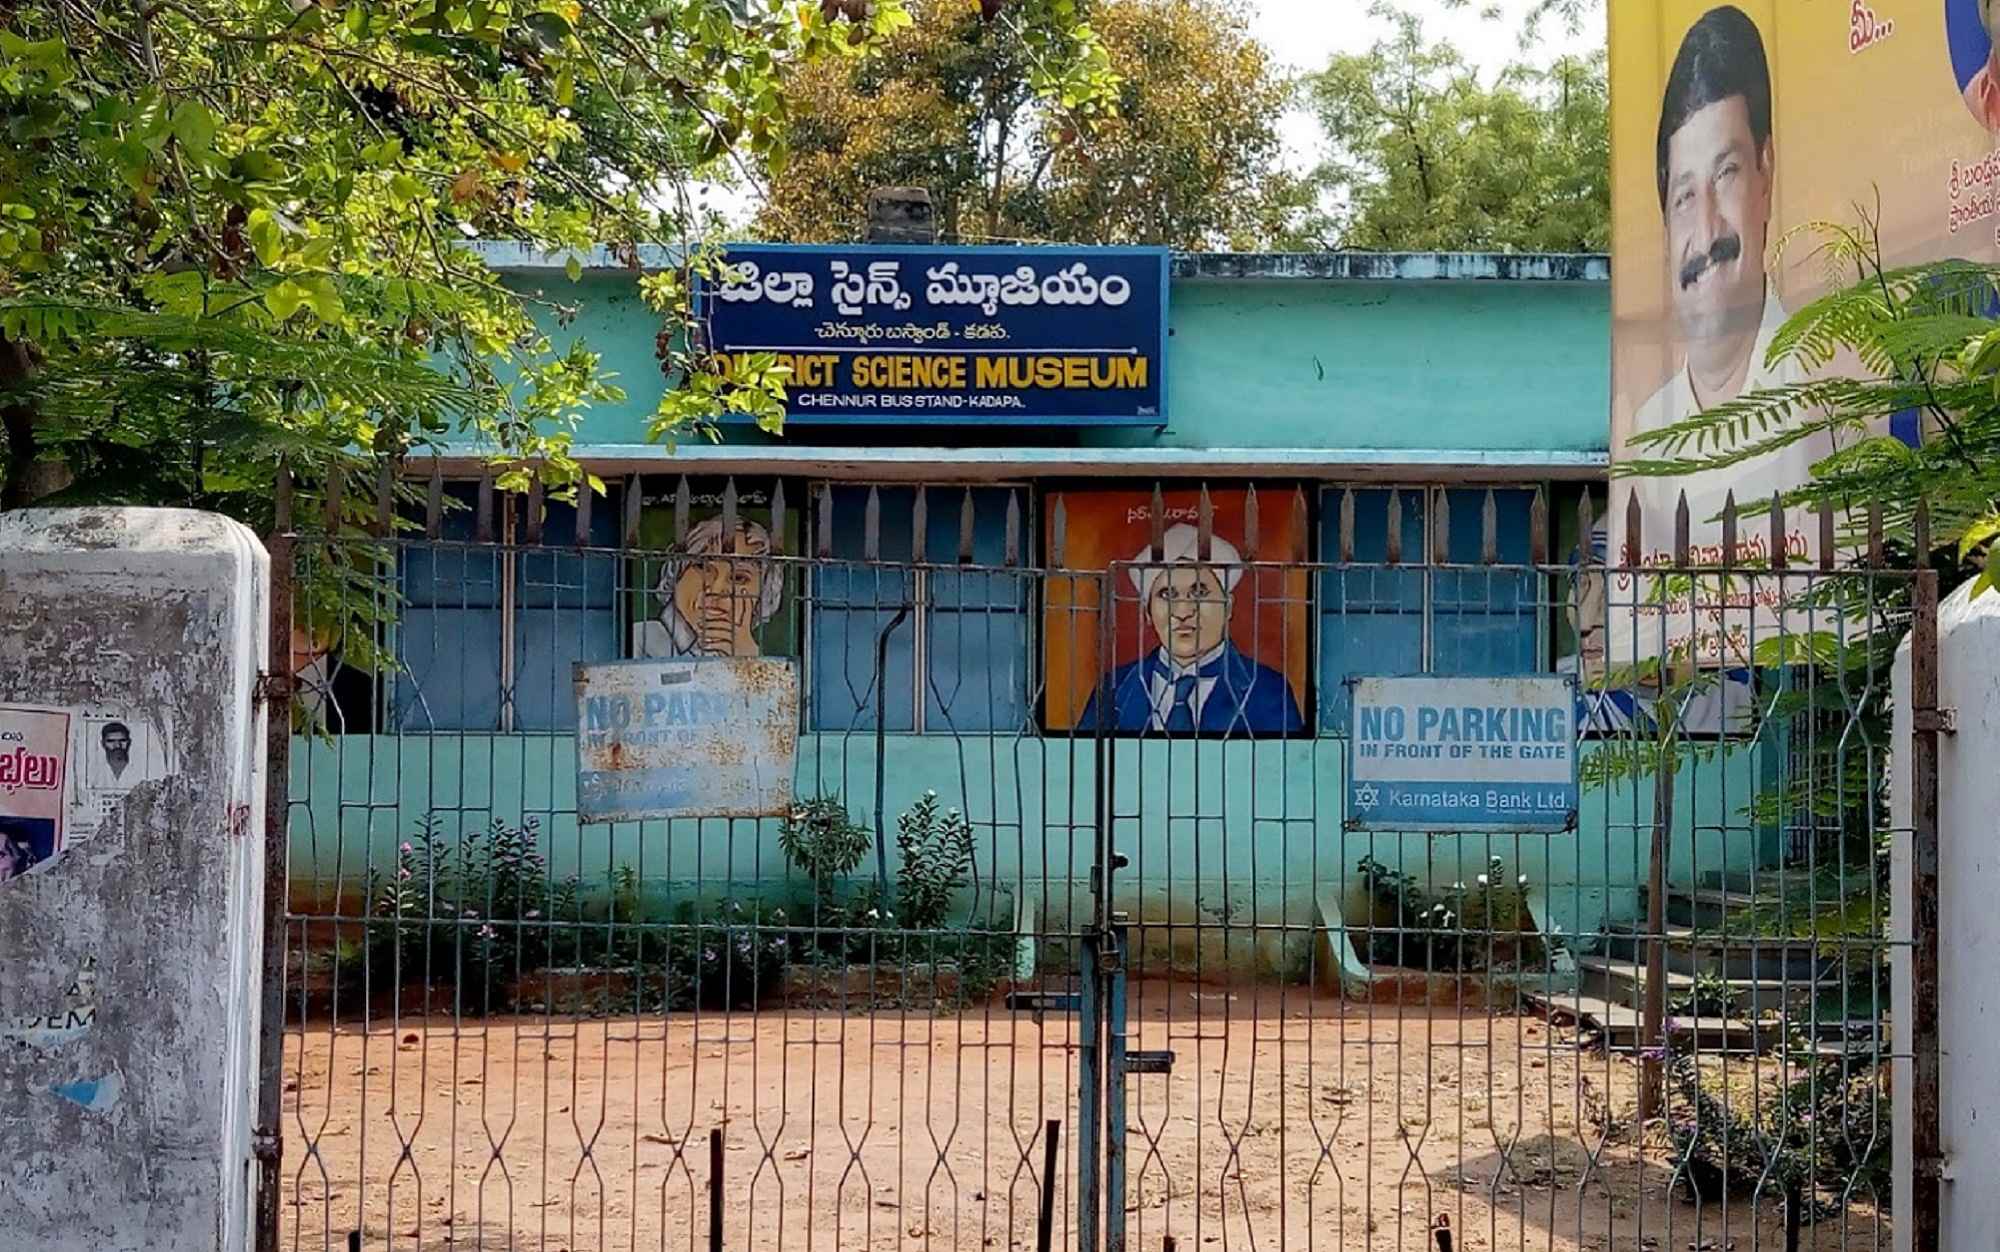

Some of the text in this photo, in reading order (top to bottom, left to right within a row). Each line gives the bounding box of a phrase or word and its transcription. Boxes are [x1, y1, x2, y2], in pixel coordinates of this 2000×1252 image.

[720, 261, 1131, 316] జిల్లా సైన్స్ మ్యూజియం
[852, 355, 966, 388] SCIENCE
[976, 356, 1148, 389] MUSEUM
[799, 394, 877, 407] CHENNUR
[587, 696, 631, 730] NO
[1361, 706, 1566, 743] NO PARKING
[1360, 744, 1565, 759] IN FRONT OF THE GATE
[1390, 789, 1570, 808] Karnataka Bank Ltd.
